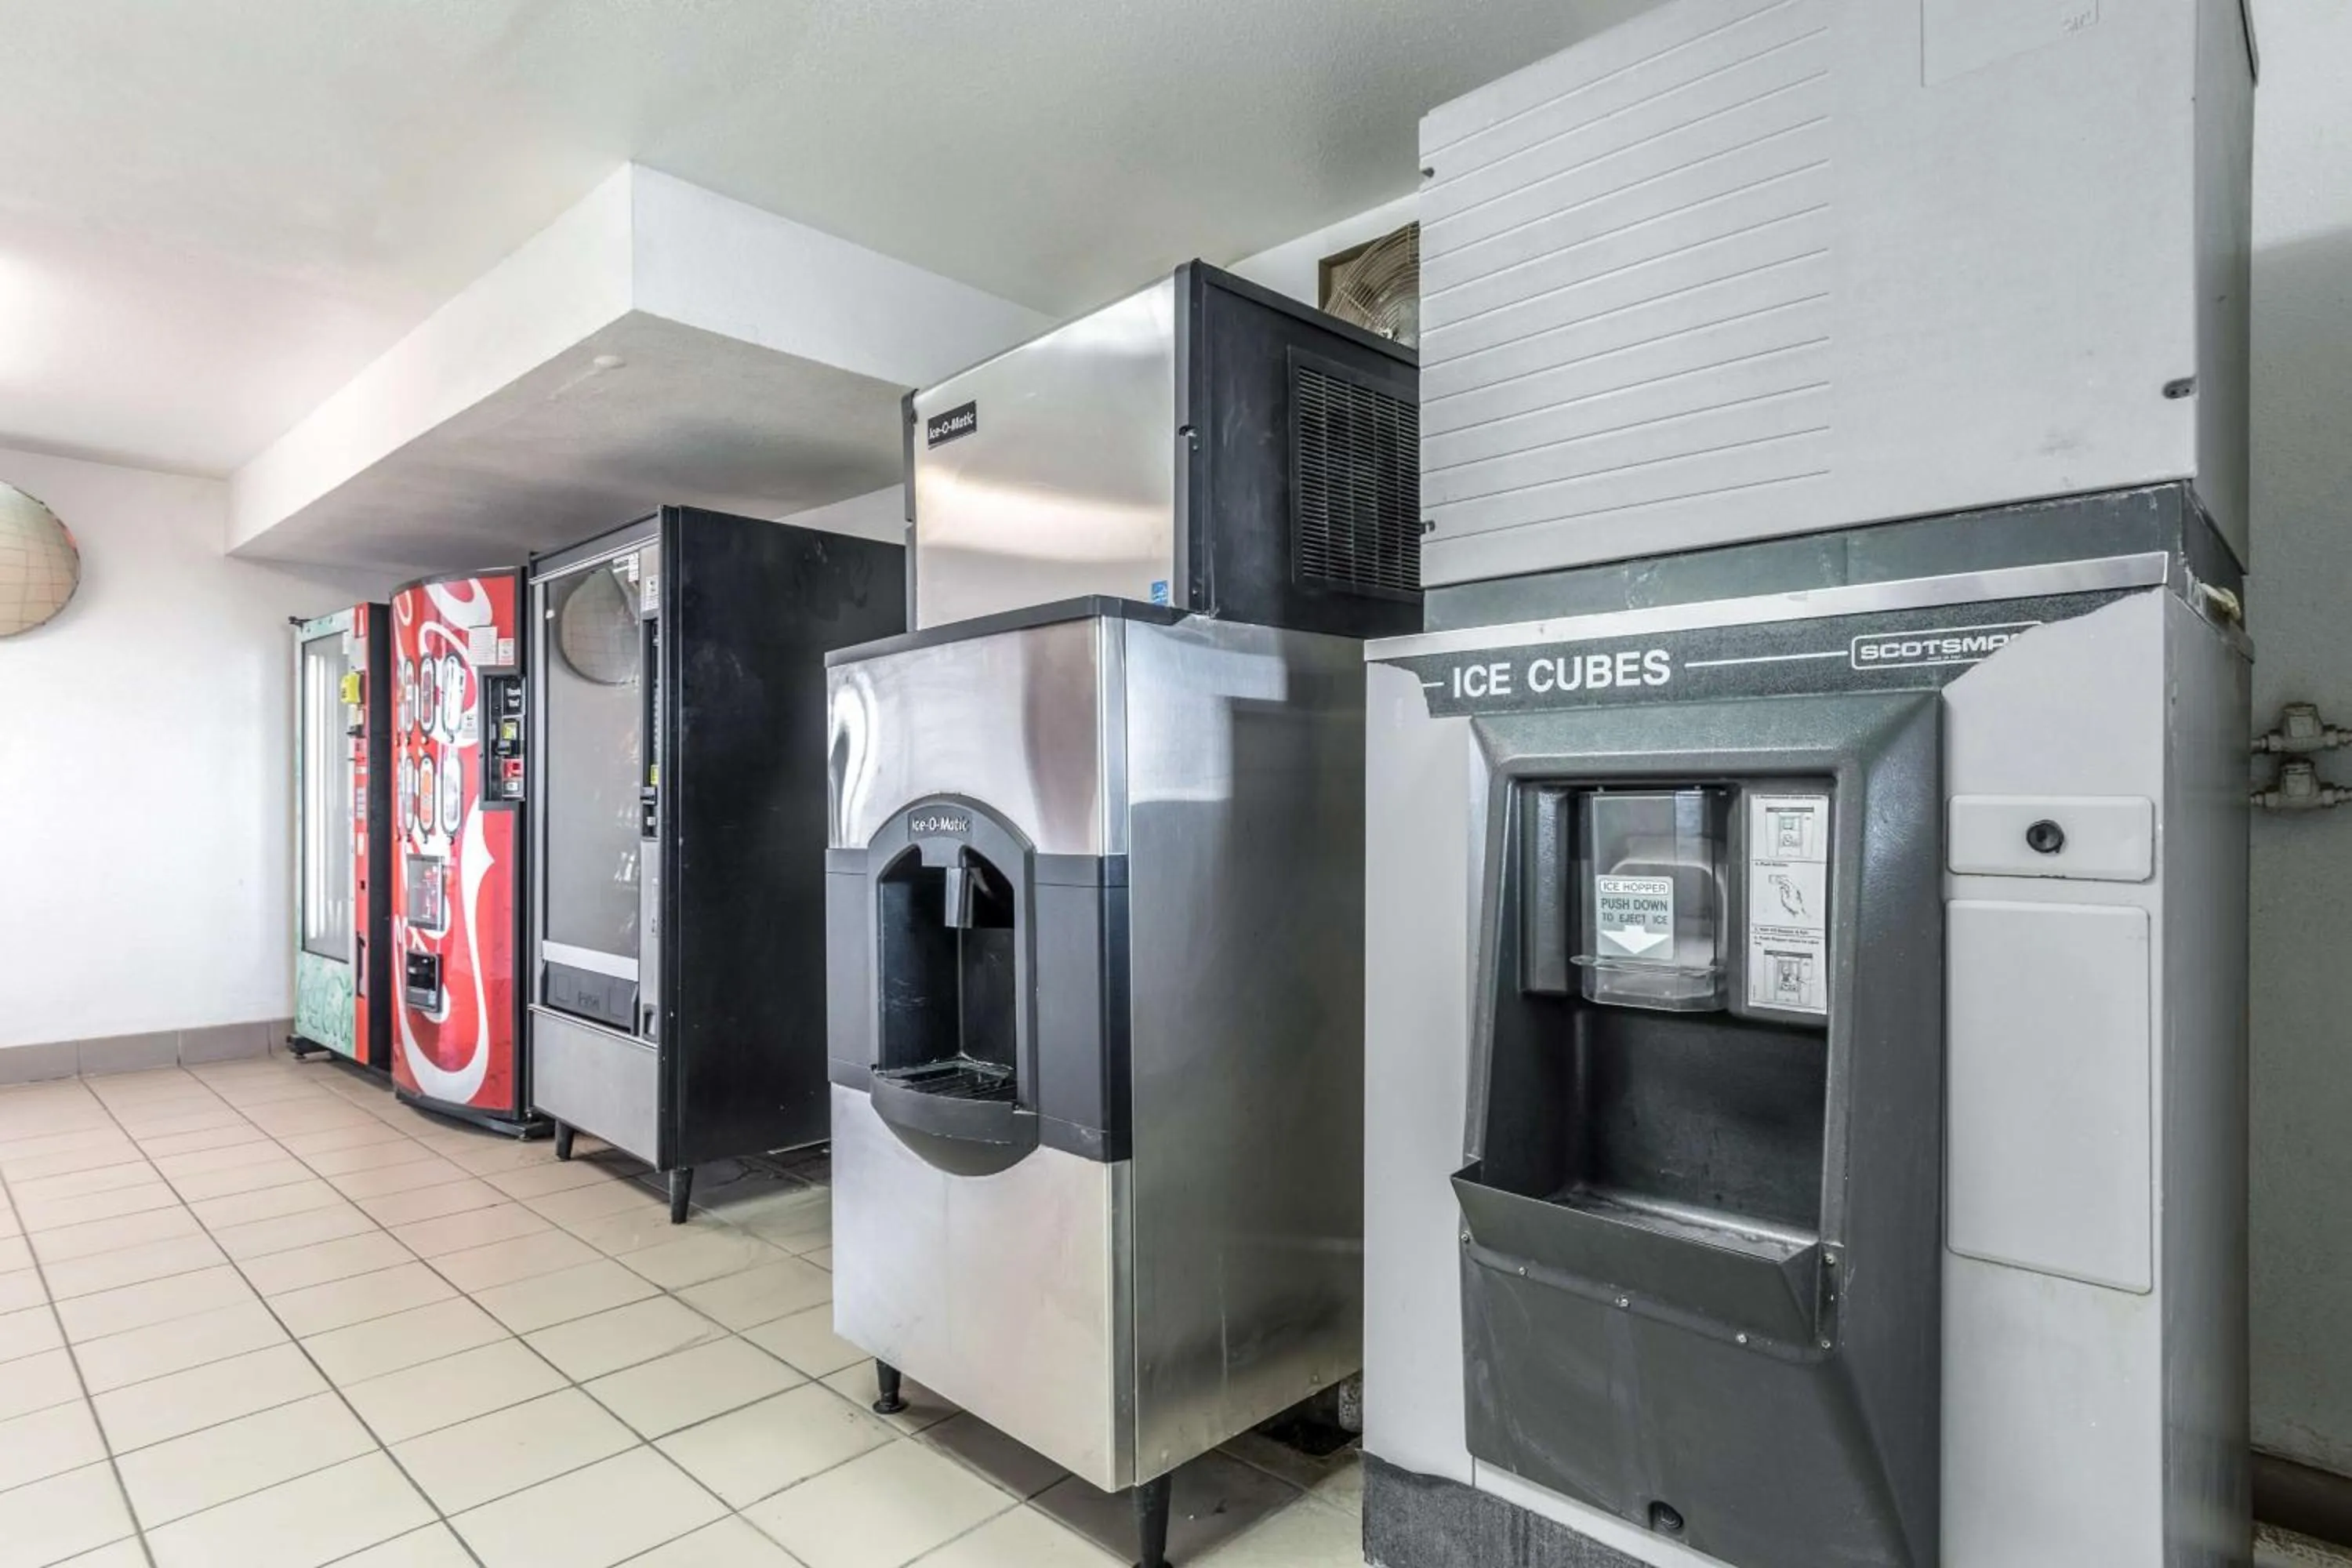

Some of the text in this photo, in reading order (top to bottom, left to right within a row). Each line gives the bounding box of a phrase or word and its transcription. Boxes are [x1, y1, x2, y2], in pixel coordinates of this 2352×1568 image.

[928, 412, 974, 439] Ice-O-Matic
[1860, 633, 2020, 660] SCOTSMA
[1454, 648, 1671, 698] ICE CUBES
[912, 817, 967, 831] Ice-O-Matic
[1603, 882, 1666, 893] ICE HOPPER
[1601, 898, 1668, 911] PUSH DOWN
[1602, 912, 1668, 924] TO EJECT ICE
